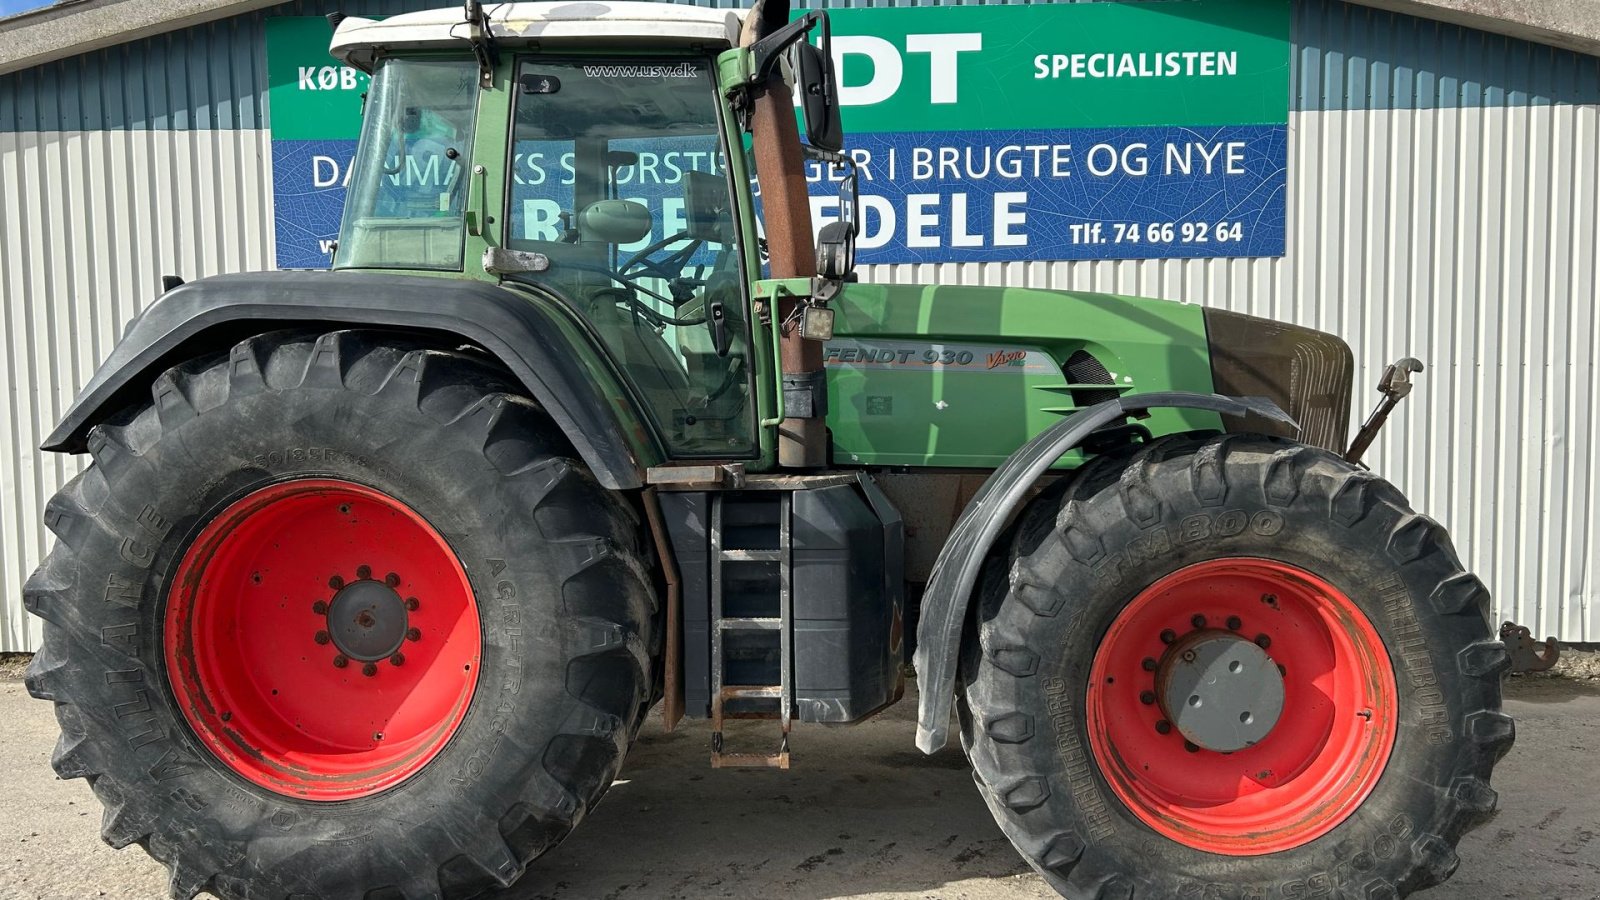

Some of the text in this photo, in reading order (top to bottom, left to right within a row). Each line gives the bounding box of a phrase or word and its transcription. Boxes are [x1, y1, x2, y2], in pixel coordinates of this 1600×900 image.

[583, 62, 697, 78] www.usv.dk
[1033, 51, 1238, 79] SPECIALISTEN
[888, 147, 896, 181] I
[911, 143, 1072, 181] BRUGTE
[1086, 142, 1148, 177] OG
[1165, 141, 1246, 176] NYE
[1069, 221, 1244, 245] Tlf. 74 66 92 64
[823, 346, 974, 365] FENDT 930
[100, 503, 195, 785] ALLIANCE
[1374, 570, 1455, 747] TRELLEBORG
[1041, 676, 1116, 847] TRELLEBORG
